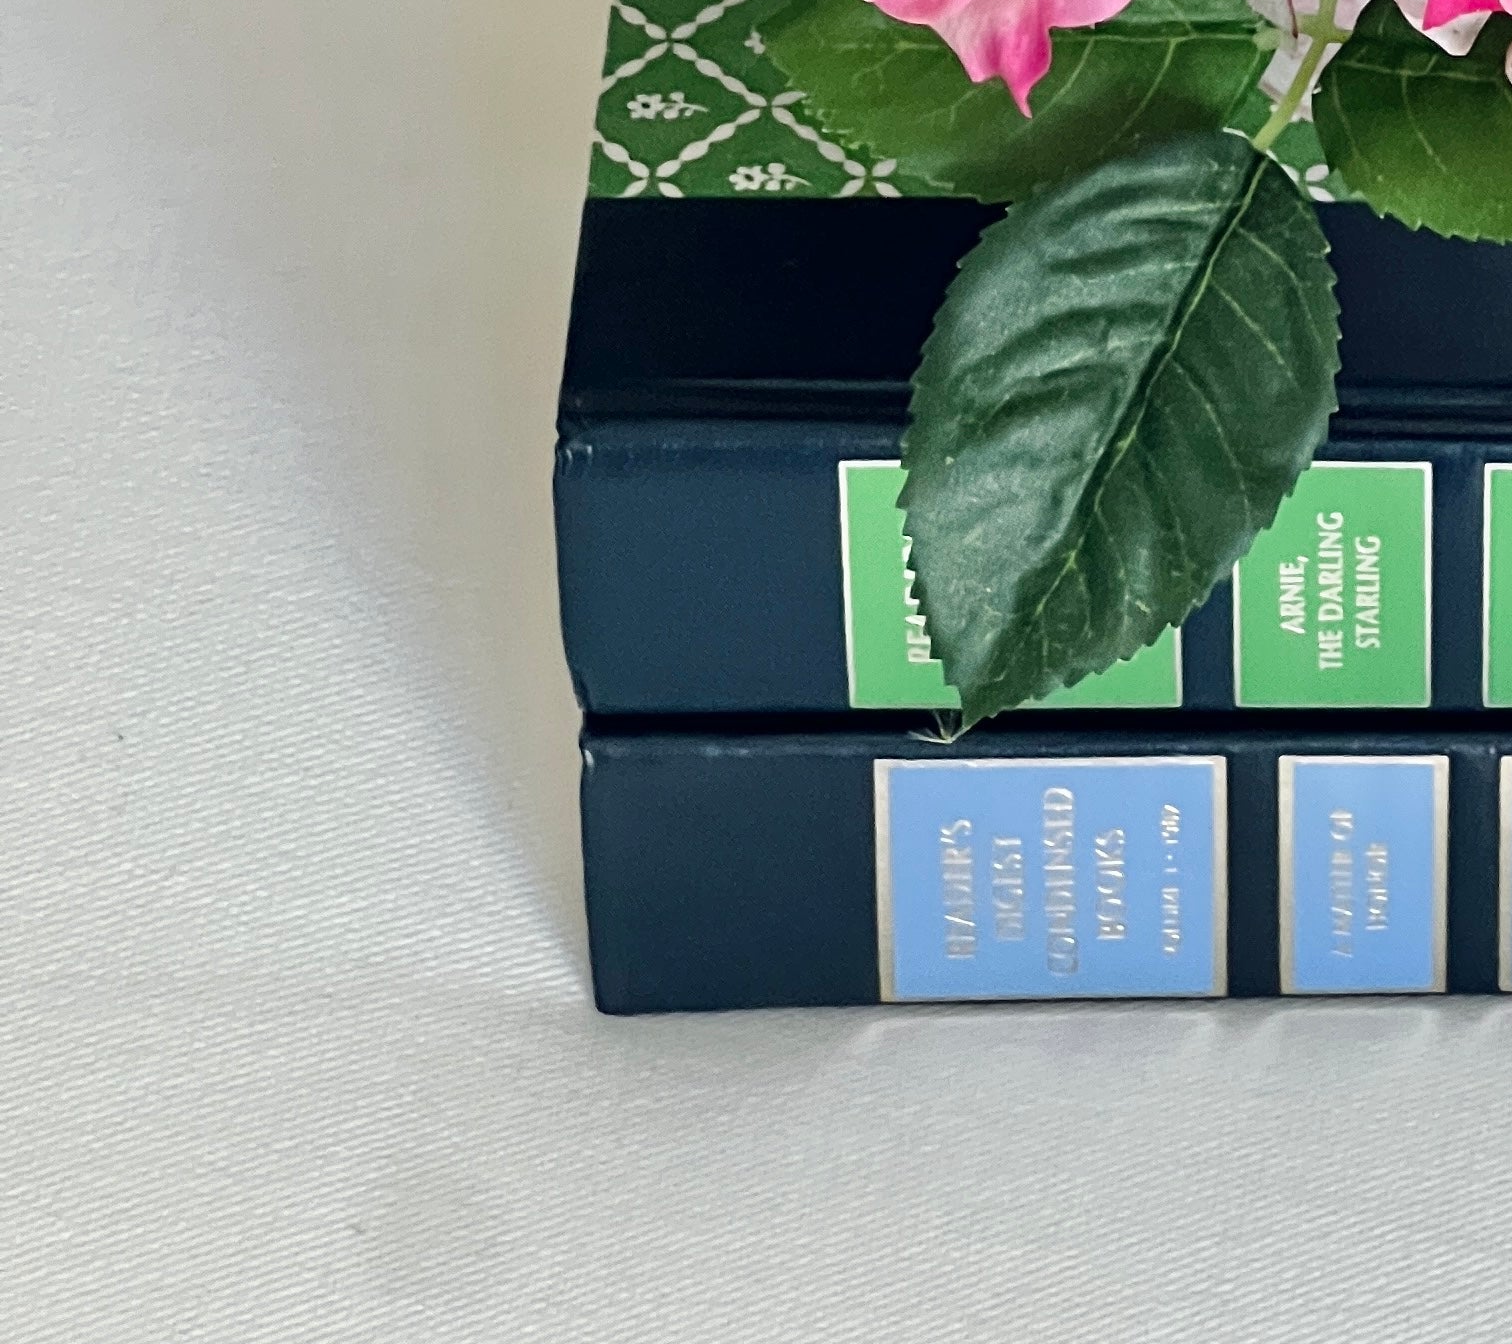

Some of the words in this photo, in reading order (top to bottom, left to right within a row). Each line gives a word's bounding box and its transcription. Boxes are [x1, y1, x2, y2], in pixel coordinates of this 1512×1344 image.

[1279, 555, 1308, 634] ARNIE,
[1316, 512, 1343, 620] DARLING
[1355, 535, 1380, 648] STARLING
[1317, 630, 1343, 670] THE
[940, 819, 976, 959] READER'S
[993, 836, 1023, 941] DIGEST
[1043, 787, 1078, 975] CONDENSED
[1095, 828, 1126, 940] BOOKS
